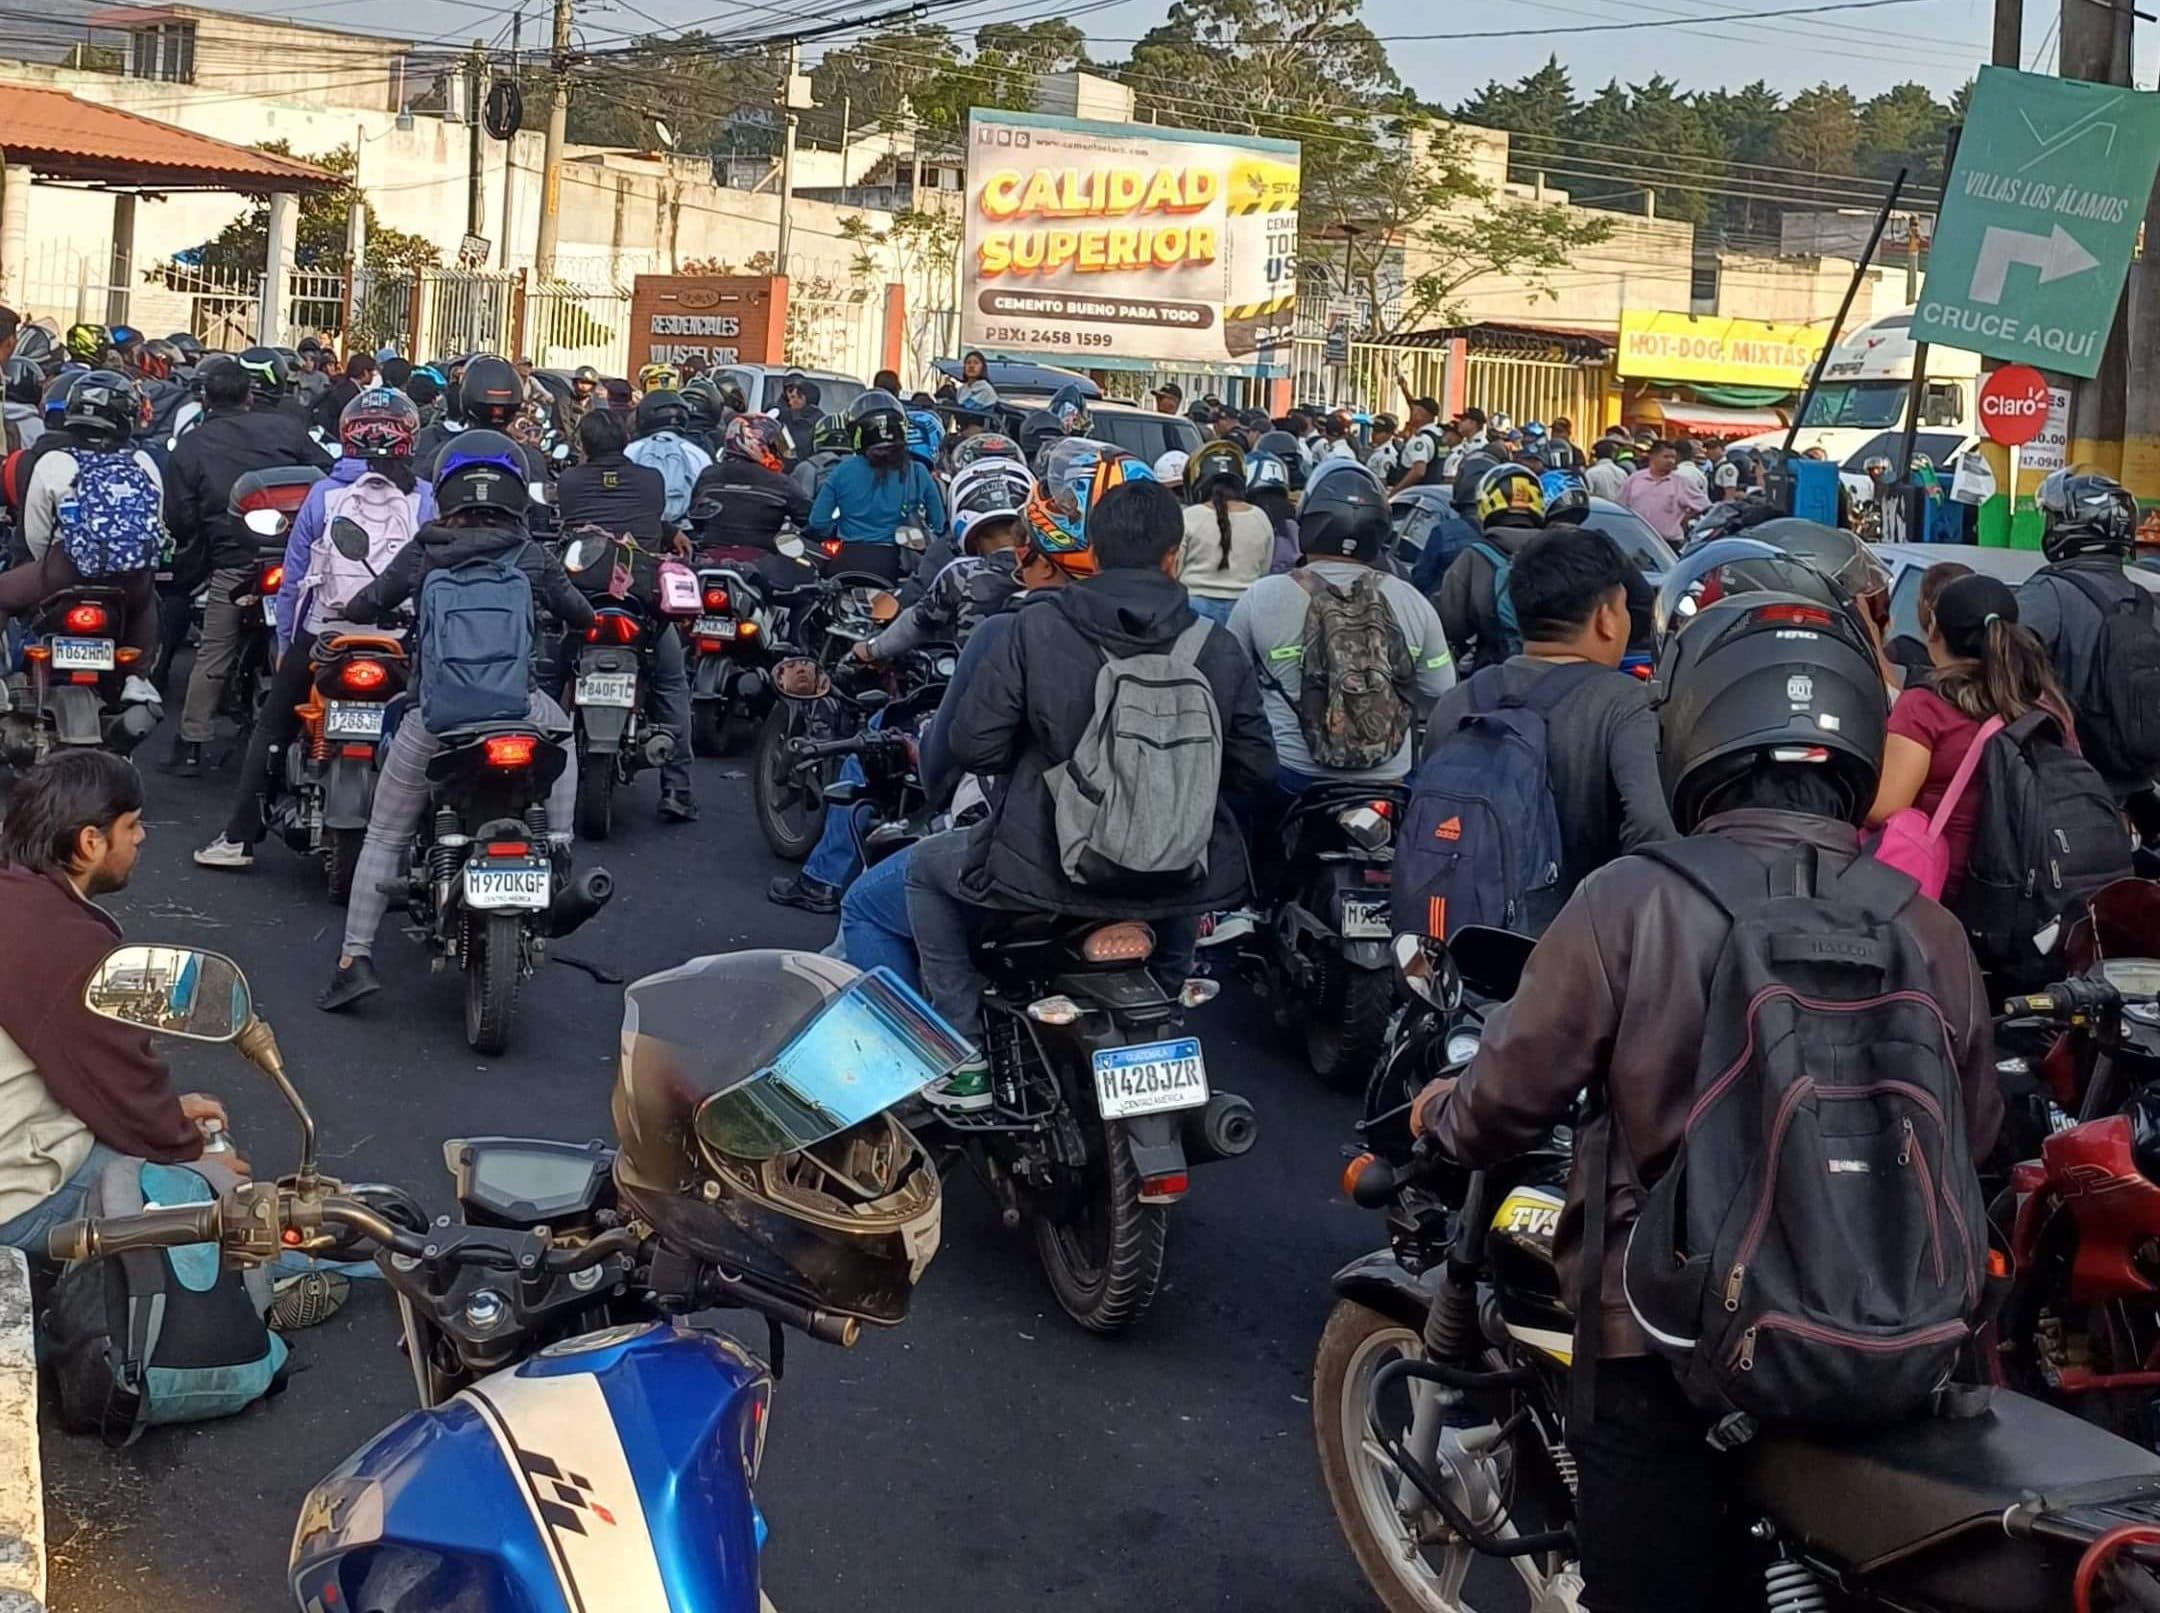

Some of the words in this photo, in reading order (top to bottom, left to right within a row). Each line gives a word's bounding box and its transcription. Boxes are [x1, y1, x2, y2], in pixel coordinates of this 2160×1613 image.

[981, 167, 1218, 220] CALIDAD
[1965, 171, 2021, 202] VILLAS
[2020, 181, 2055, 209] LOS
[2054, 183, 2128, 223] ÁLAMOS
[980, 225, 1217, 277] SUPERIOR
[994, 297, 1063, 313] CEMENTO
[1067, 301, 1116, 317] BUENO
[1120, 306, 1157, 320] PARA
[1160, 308, 1200, 322] TODO
[650, 315, 740, 337] RESIDENCIALES
[986, 327, 1025, 342] PBX:
[1031, 330, 1071, 344] 2458
[1076, 332, 1113, 346] 1599
[1922, 302, 2019, 340] CRUCE
[2024, 324, 2097, 357] AQUÍ
[1732, 342, 1807, 367] MIXTAS
[1983, 396, 2036, 416] Claro
[470, 873, 545, 893] M970KGF
[1103, 1060, 1199, 1099] M428JZR
[1508, 1207, 1560, 1236] TVS
